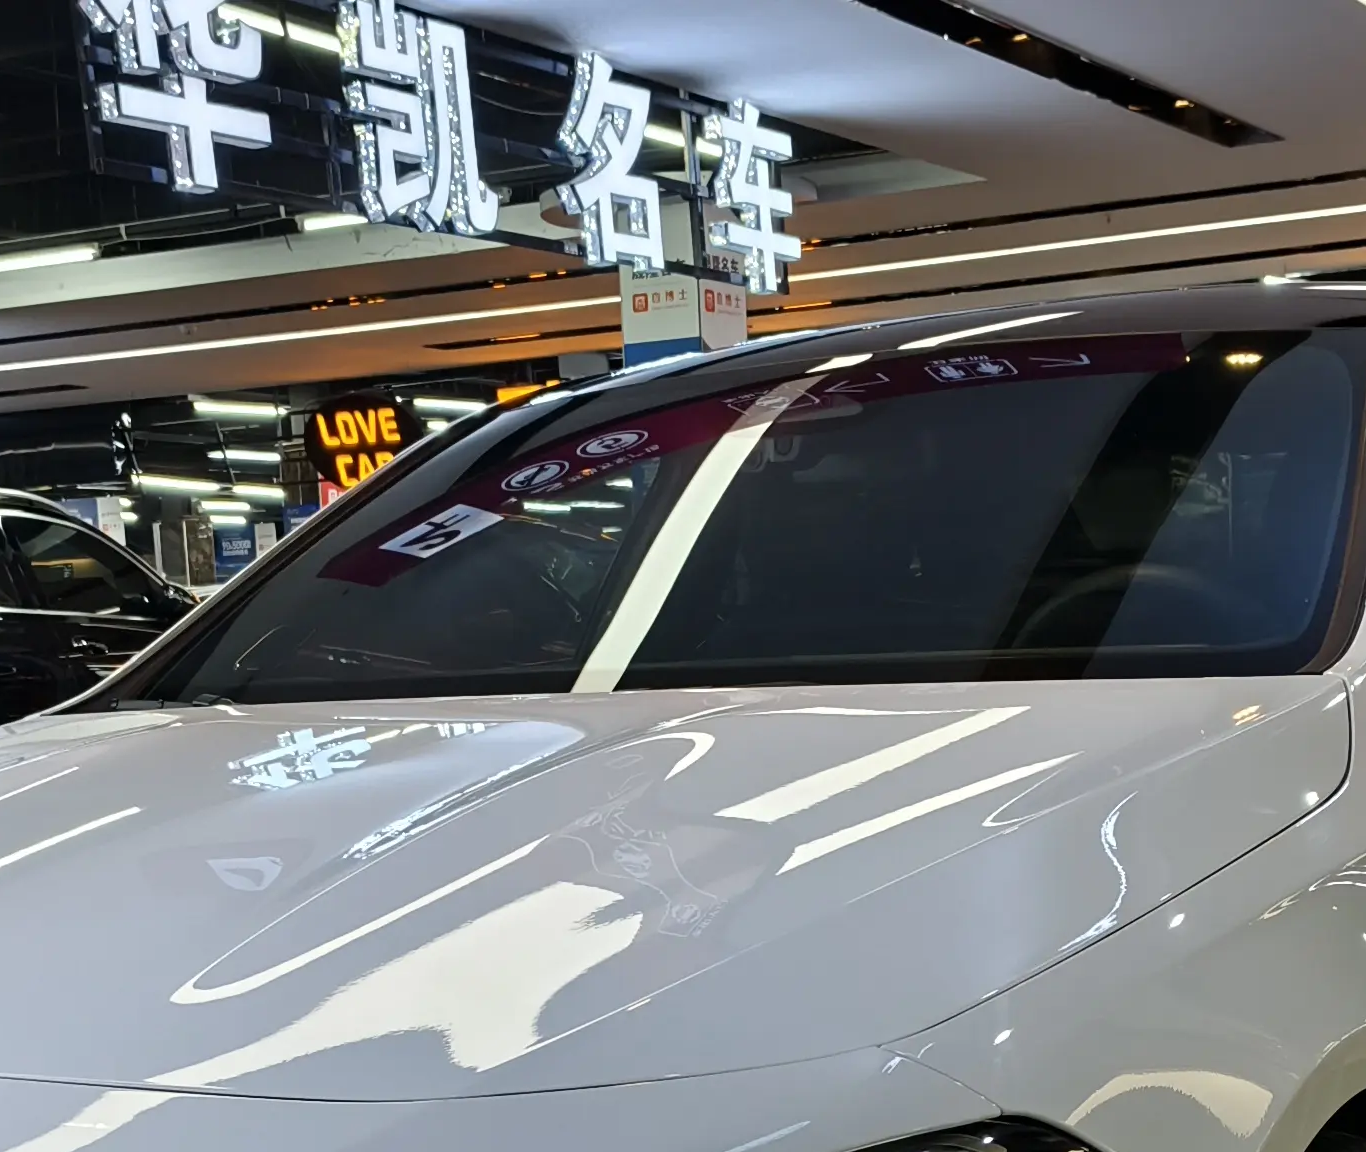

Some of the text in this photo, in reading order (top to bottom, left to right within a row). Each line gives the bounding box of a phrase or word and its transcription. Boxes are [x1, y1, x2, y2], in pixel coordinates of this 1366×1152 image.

[79, 0, 800, 295] 华凯名车
[316, 407, 401, 447] LOVE
